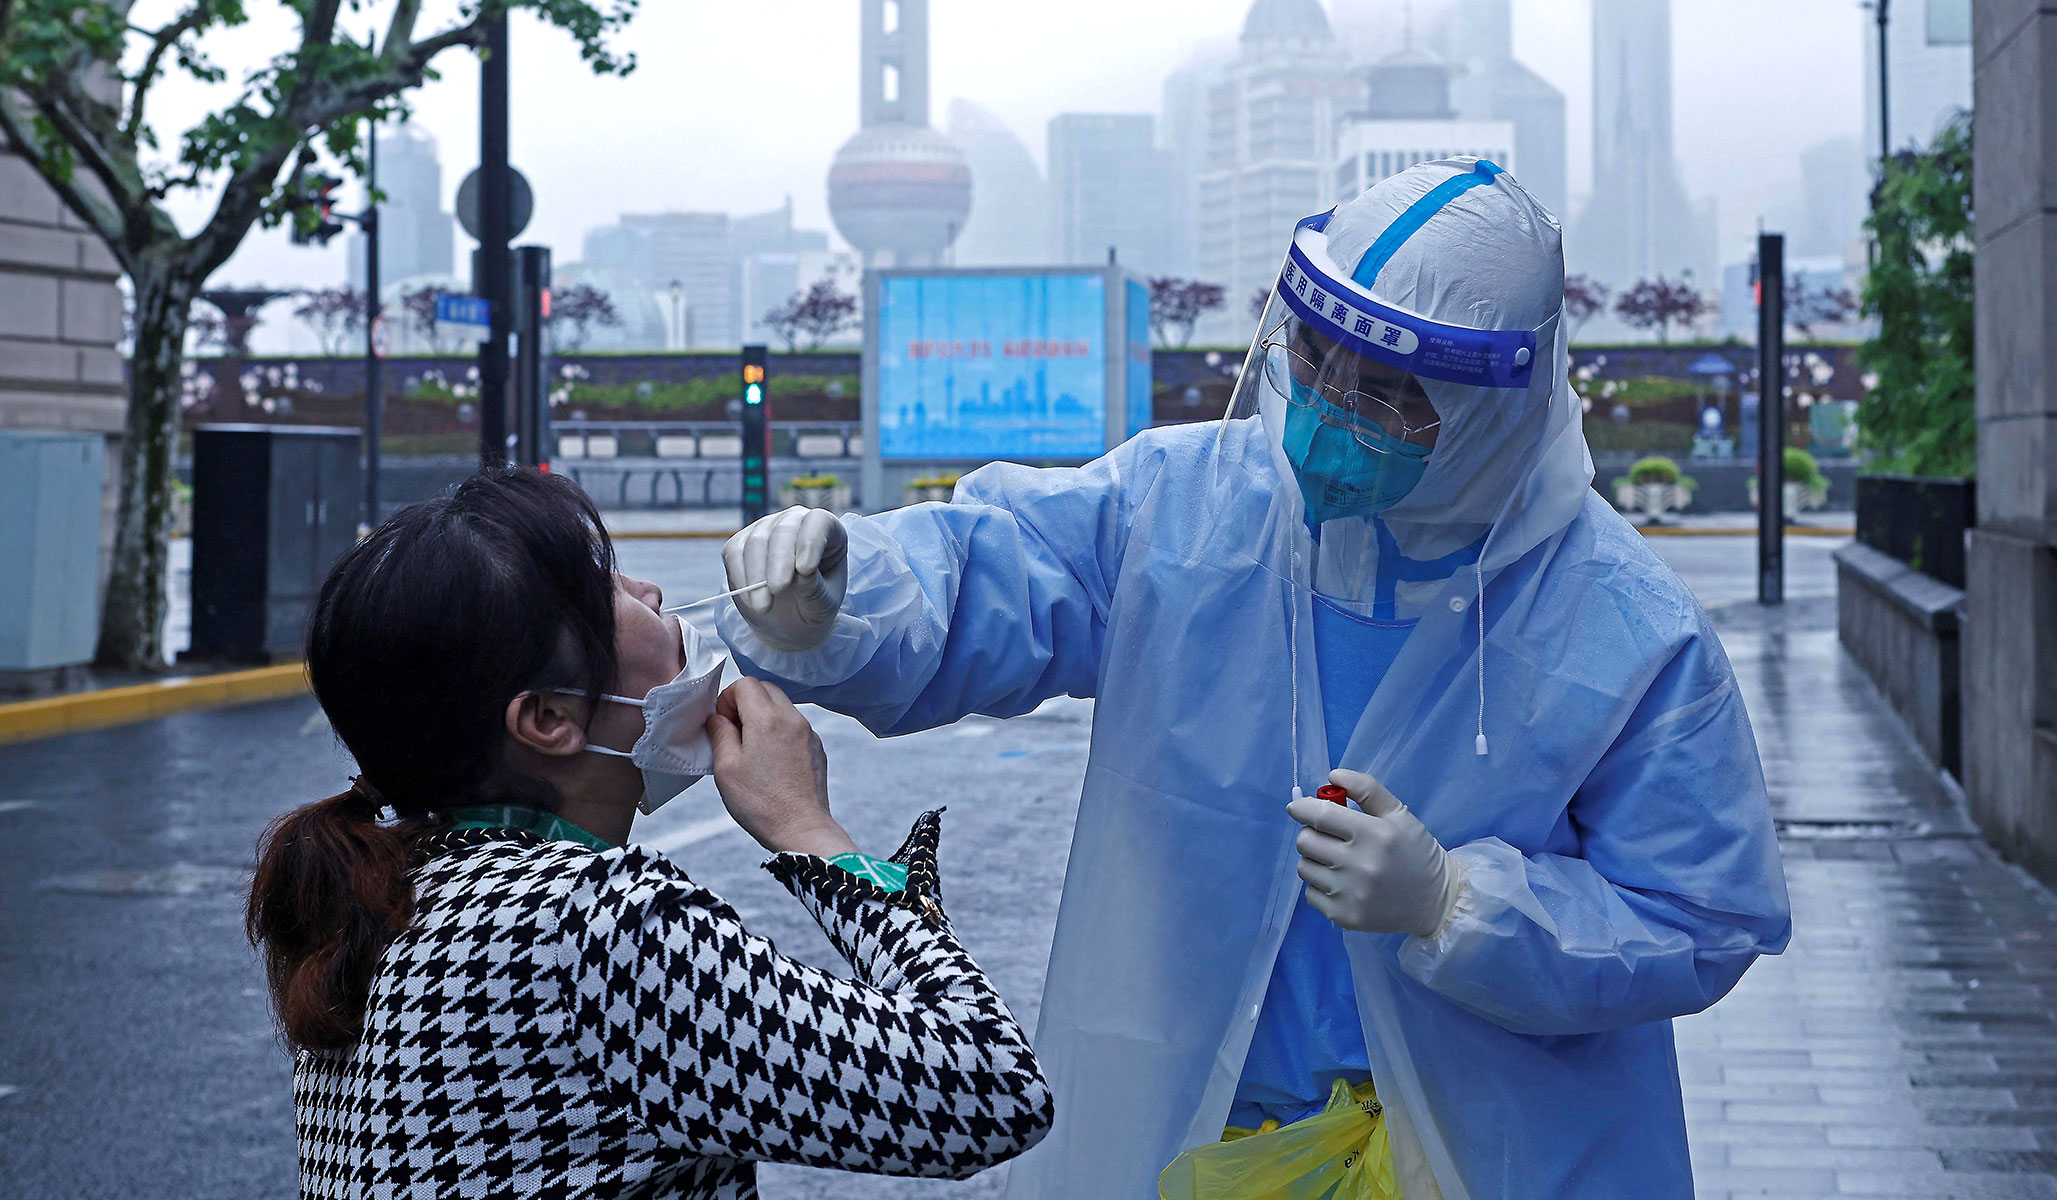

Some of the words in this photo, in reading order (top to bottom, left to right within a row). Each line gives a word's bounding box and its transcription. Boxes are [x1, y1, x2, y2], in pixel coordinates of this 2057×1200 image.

[1285, 261, 1402, 347] 医用隔离面罩
